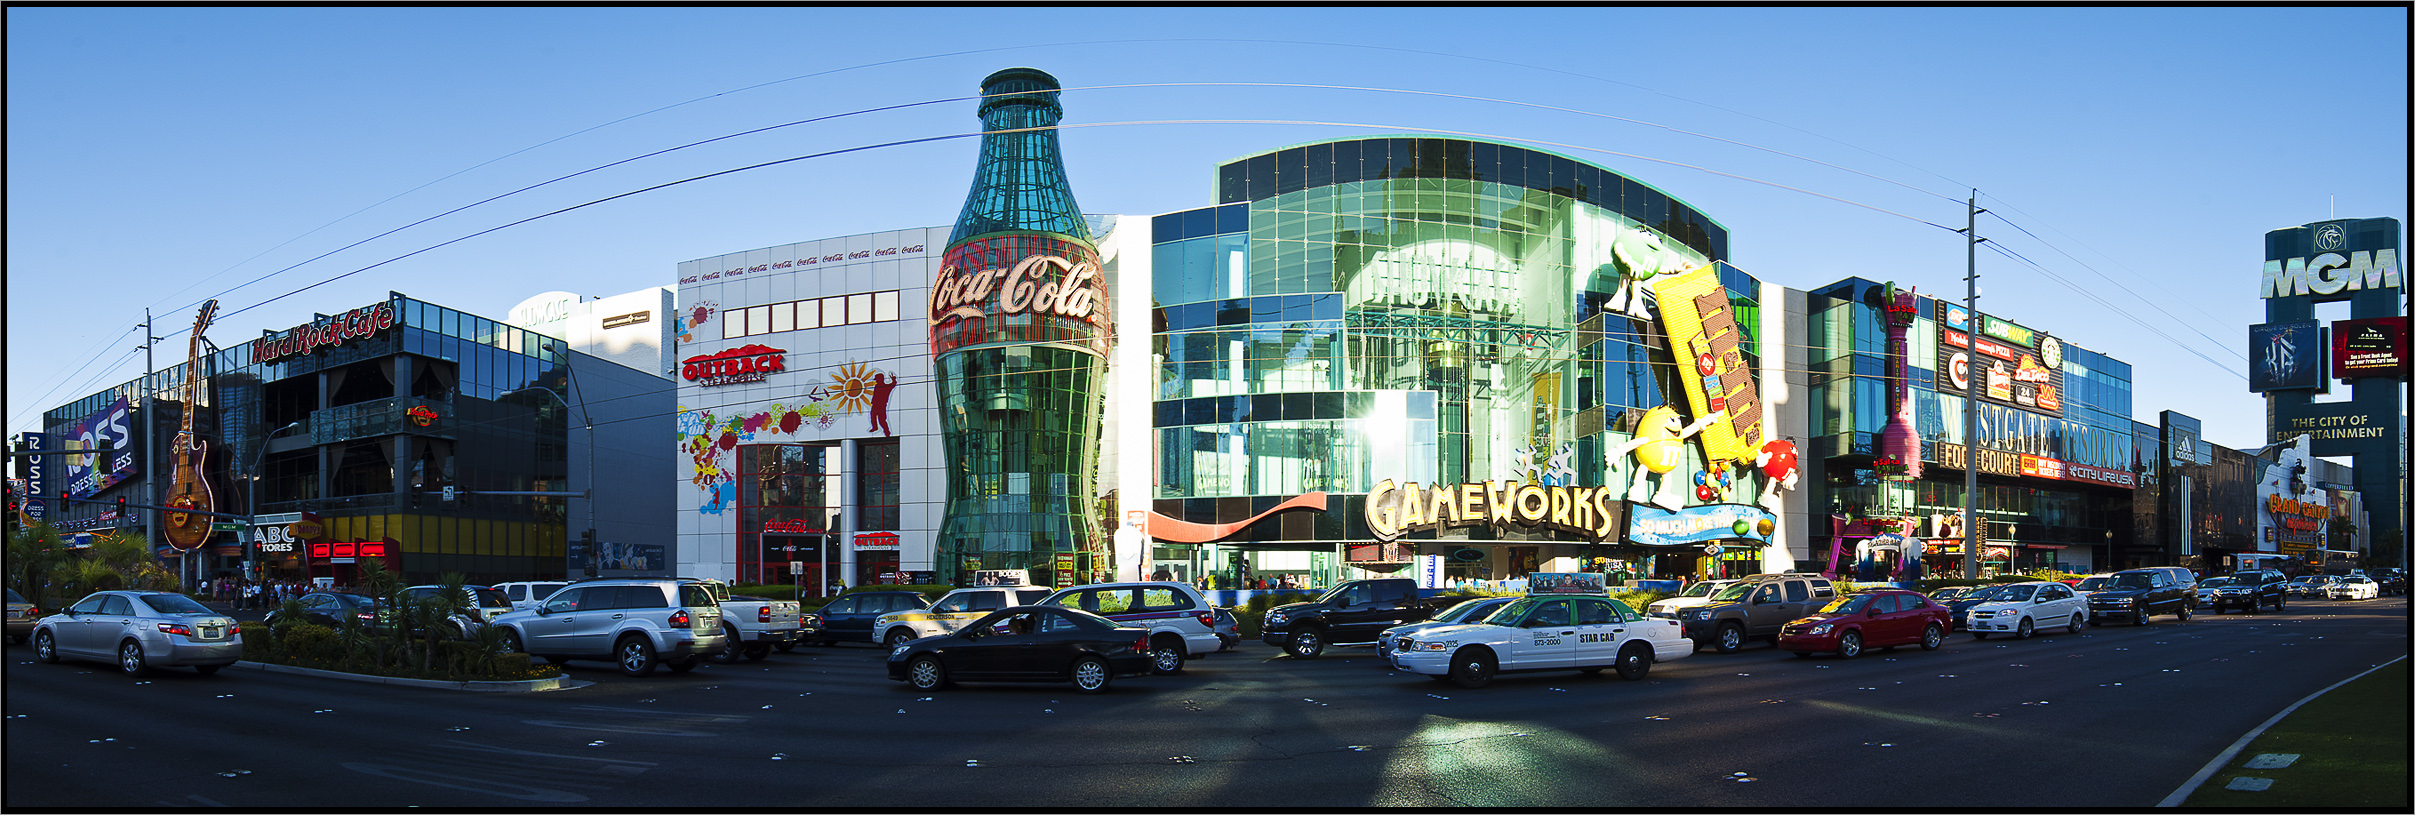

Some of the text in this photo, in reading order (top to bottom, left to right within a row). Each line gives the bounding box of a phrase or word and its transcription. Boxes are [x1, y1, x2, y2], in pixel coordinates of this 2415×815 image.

[2260, 248, 2400, 299] MGM
[927, 254, 1097, 326] Coca-Cola
[251, 301, 393, 365] Hard Rock Cafe
[1986, 319, 2033, 345] SUBWAY
[1996, 344, 2011, 358] PIZZA
[682, 353, 784, 381] OUTBACK
[1893, 341, 1901, 387] MARGARITAS
[699, 373, 766, 388] STEAKHOUSE
[2020, 387, 2030, 397] 24
[2291, 414, 2368, 428] THE CITY OF
[1945, 395, 2125, 470] WSTGATE RESORTS
[1981, 450, 2019, 476] COURT
[2175, 450, 2195, 462] adidas
[70, 475, 94, 496] DRESS
[2077, 467, 2097, 480] CITY
[2115, 474, 2135, 486] USA
[1367, 478, 1613, 540] GAMEWORKS
[2268, 493, 2330, 520] GRAND CANYON
[1640, 519, 1655, 534] SO
[1656, 518, 1687, 535] MUCH
[1687, 517, 1714, 534] MORE
[1714, 515, 1739, 530] THAN
[254, 526, 296, 544] ABC
[854, 537, 899, 546] OUTBACK
[261, 543, 294, 552] TORES
[1446, 639, 1459, 648] 2325
[1534, 638, 1561, 647] 873-2000
[1579, 632, 1615, 643] STAR CAB
